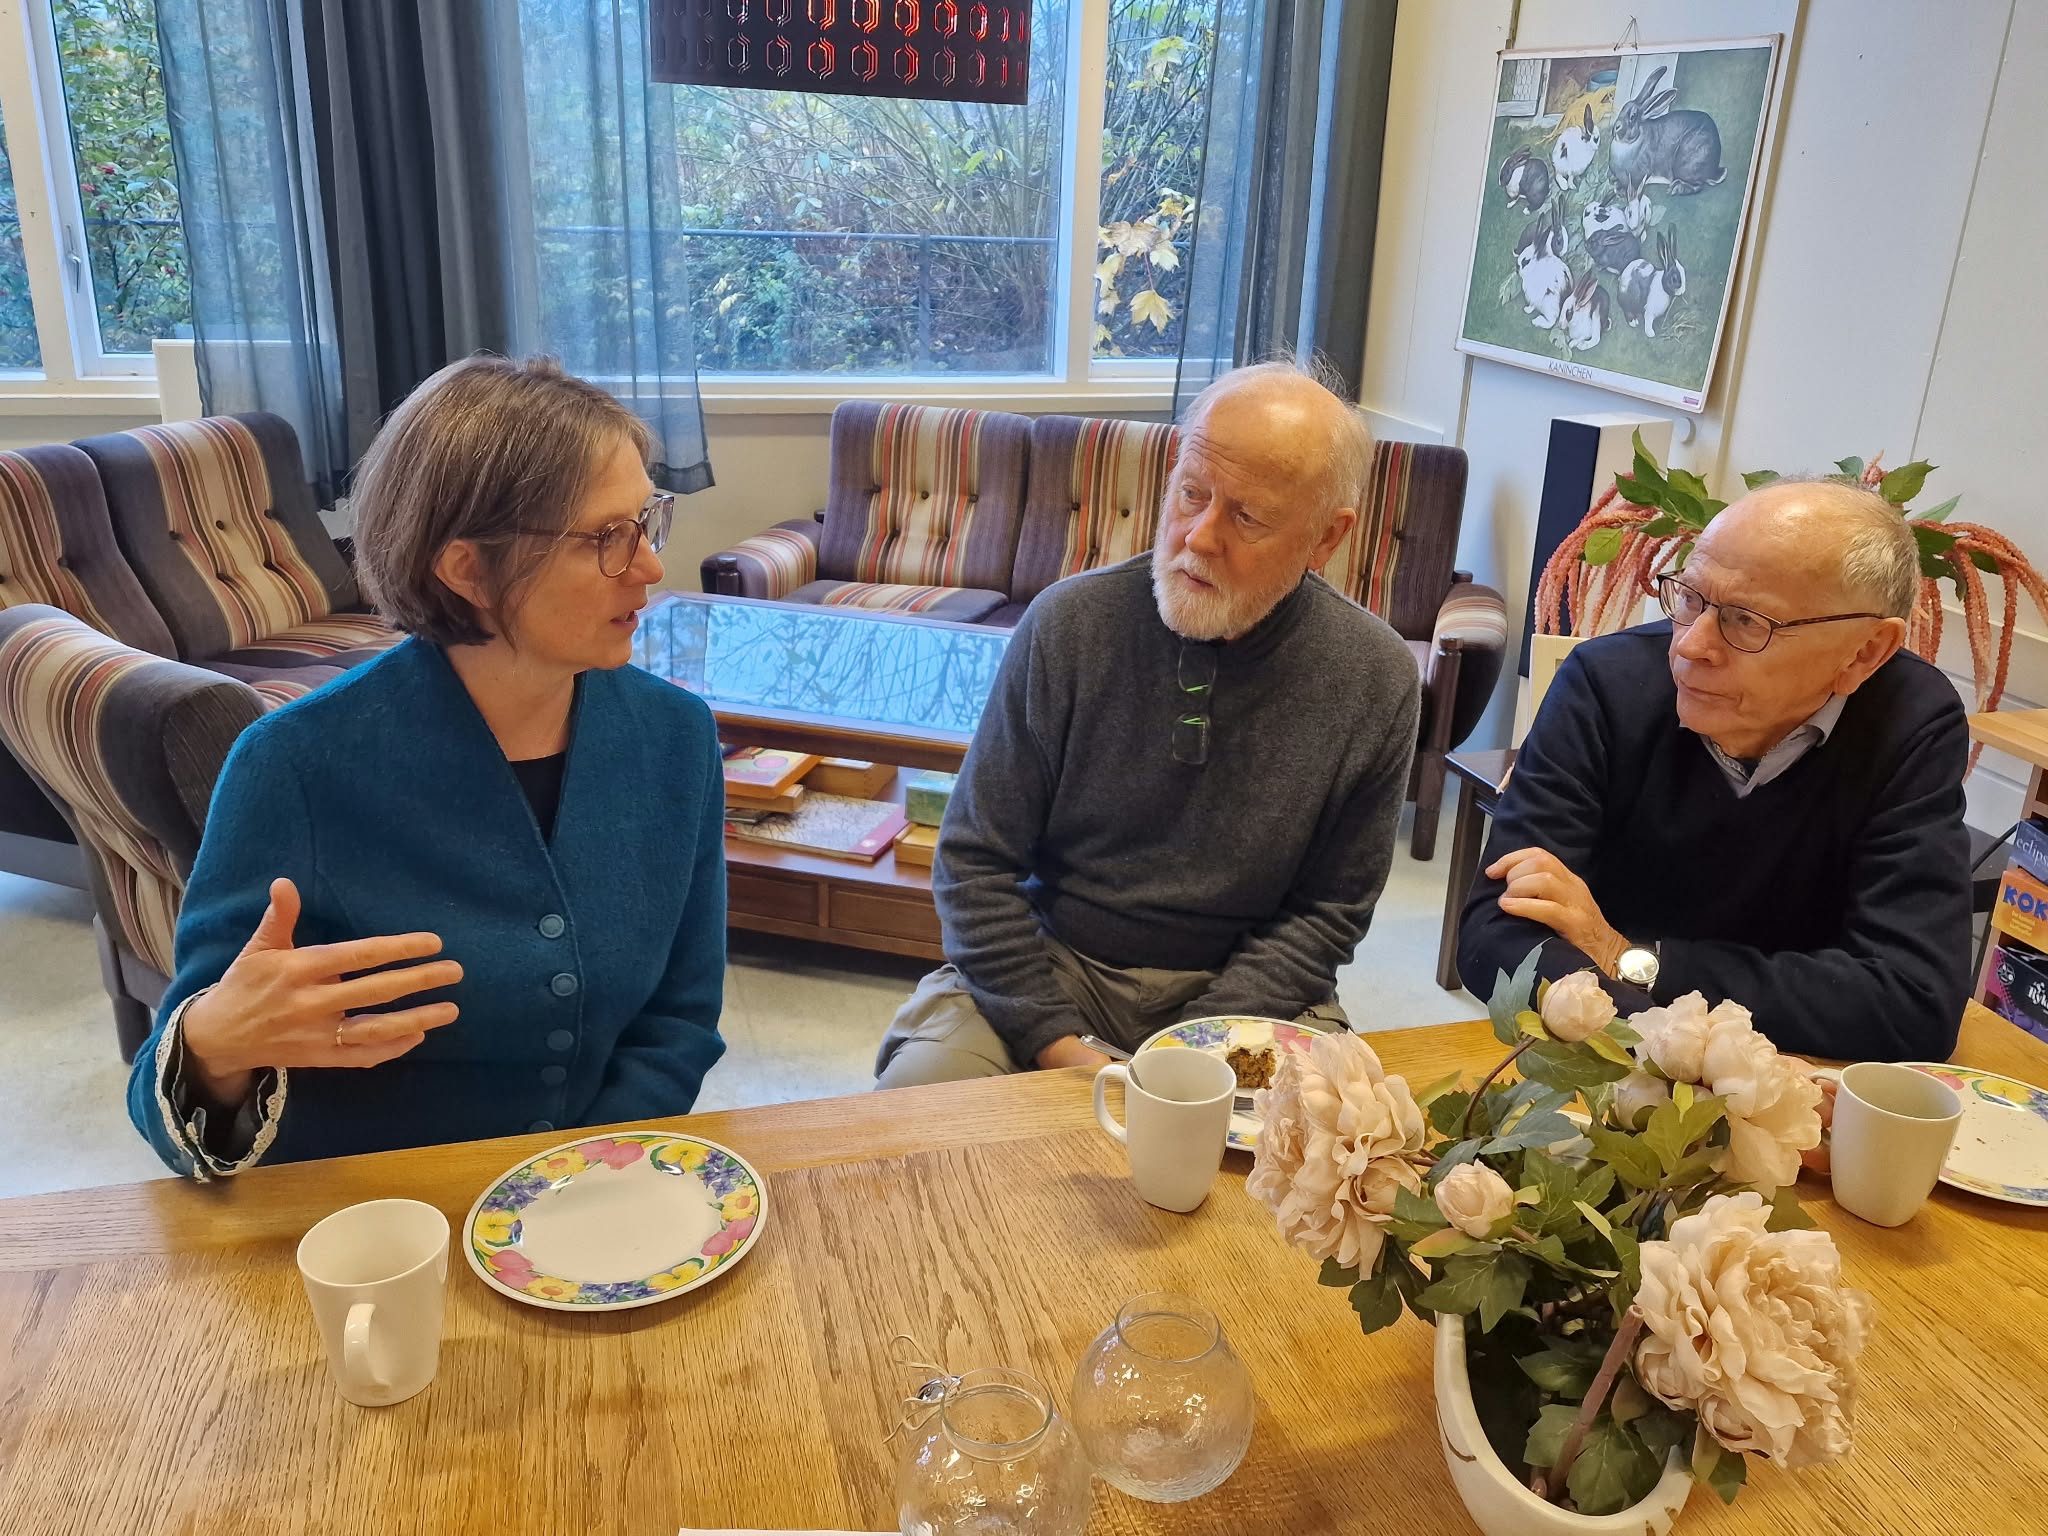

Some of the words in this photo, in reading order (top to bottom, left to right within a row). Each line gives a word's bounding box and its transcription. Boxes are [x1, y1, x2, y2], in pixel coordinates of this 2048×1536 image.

[1548, 360, 1593, 379] KANINCHEN
[2016, 838, 2048, 867] eclips
[2002, 883, 2048, 921] KOK
